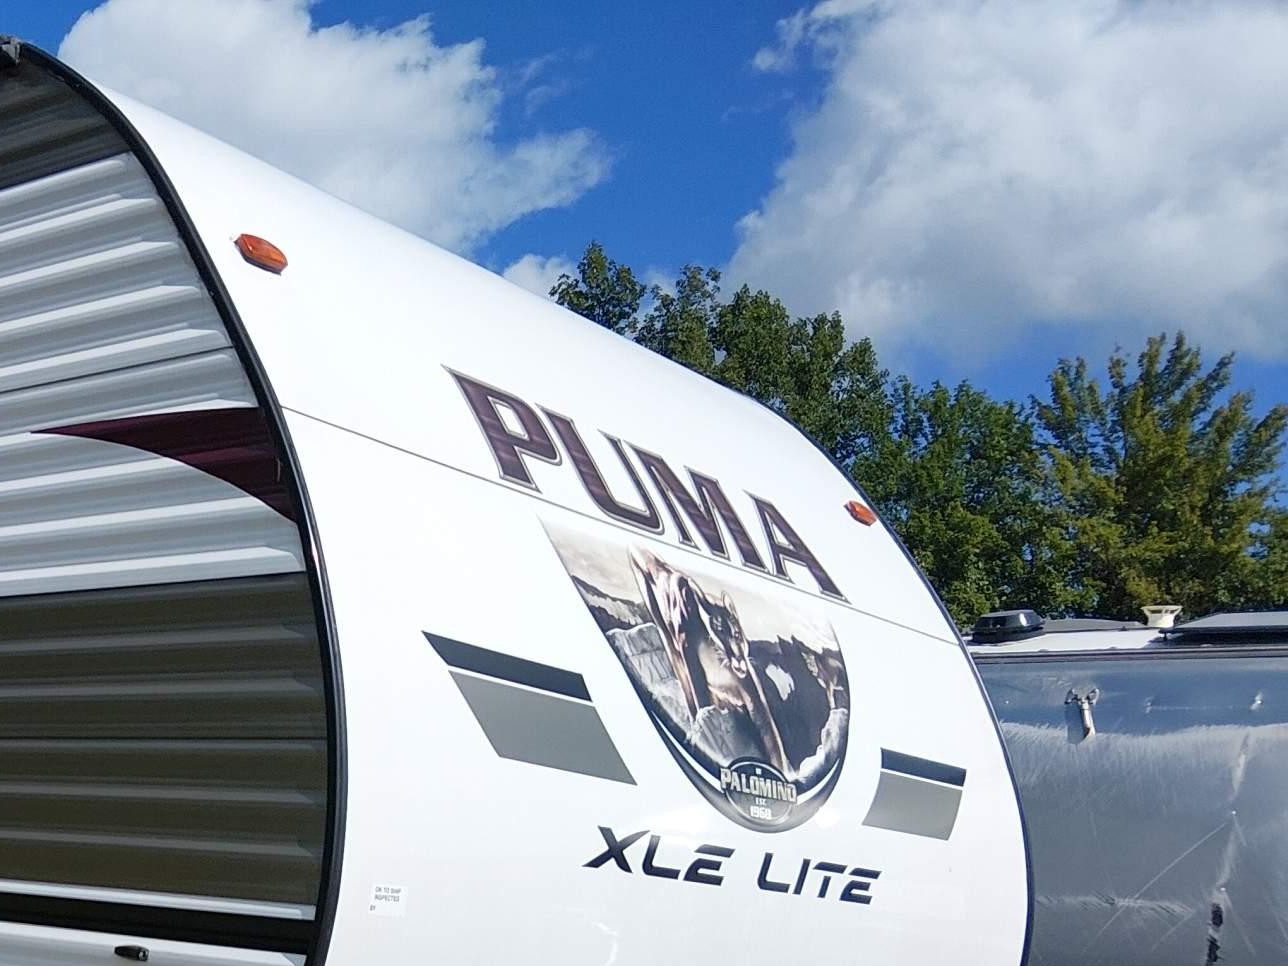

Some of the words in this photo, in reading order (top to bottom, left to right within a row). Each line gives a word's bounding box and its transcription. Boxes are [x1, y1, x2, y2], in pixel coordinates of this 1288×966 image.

[441, 364, 852, 605] PUMA
[720, 768, 798, 804] PALOMINO
[581, 825, 736, 887] XLE
[756, 852, 883, 905] LITE
